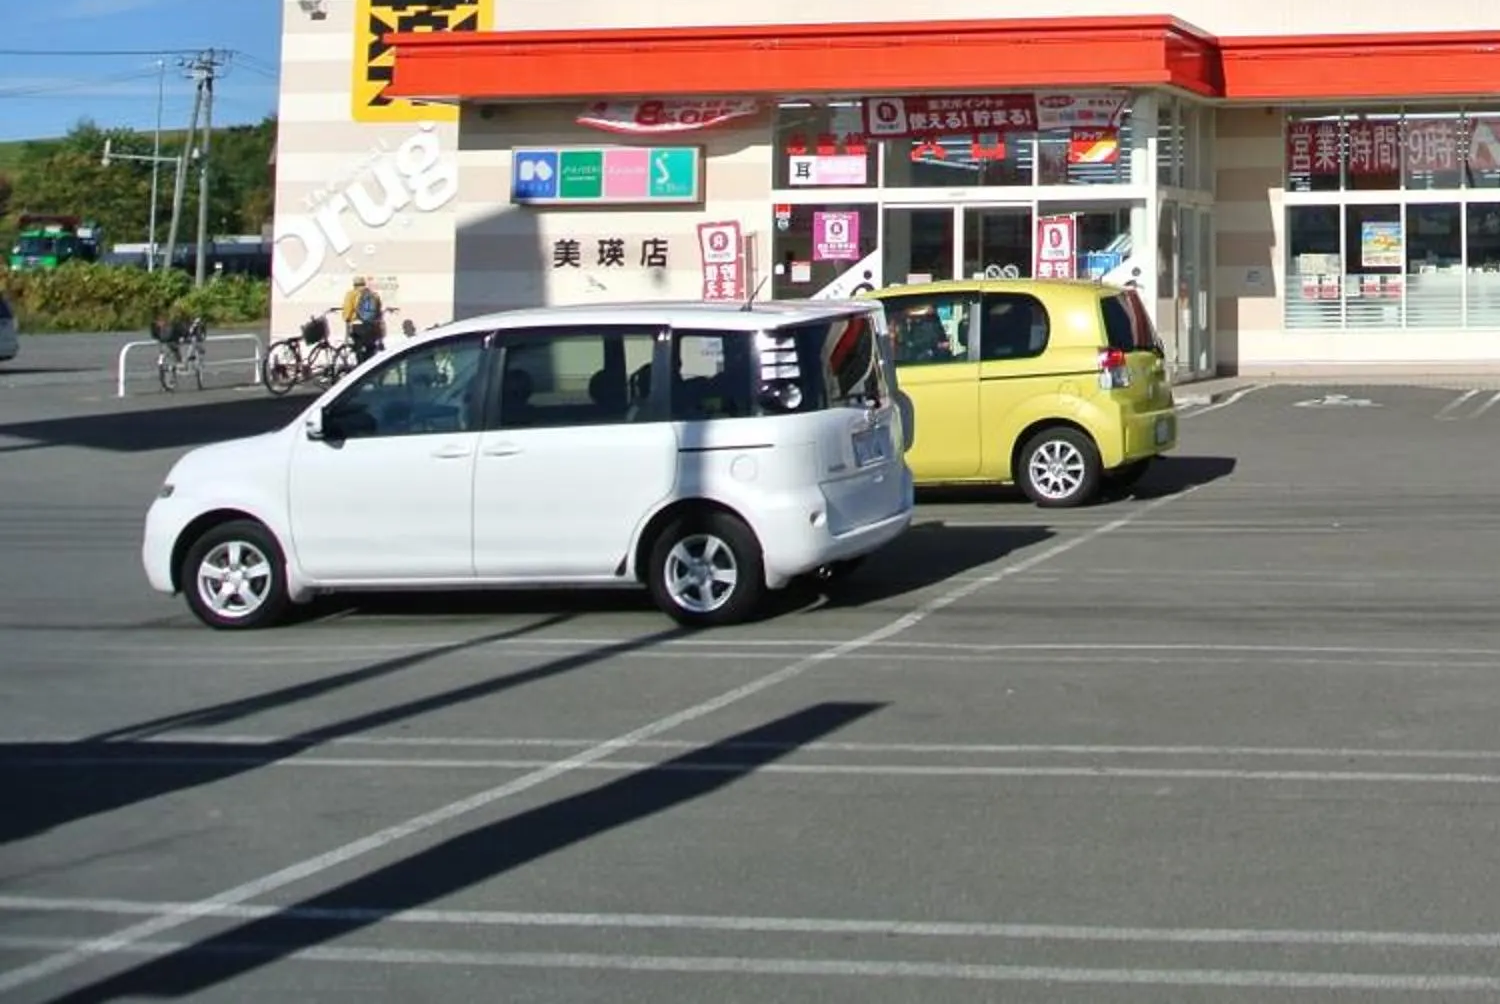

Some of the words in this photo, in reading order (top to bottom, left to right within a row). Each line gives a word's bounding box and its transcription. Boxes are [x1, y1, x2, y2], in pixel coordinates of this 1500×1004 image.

[272, 120, 459, 297] Drug
[554, 238, 668, 268] 美瑛店
